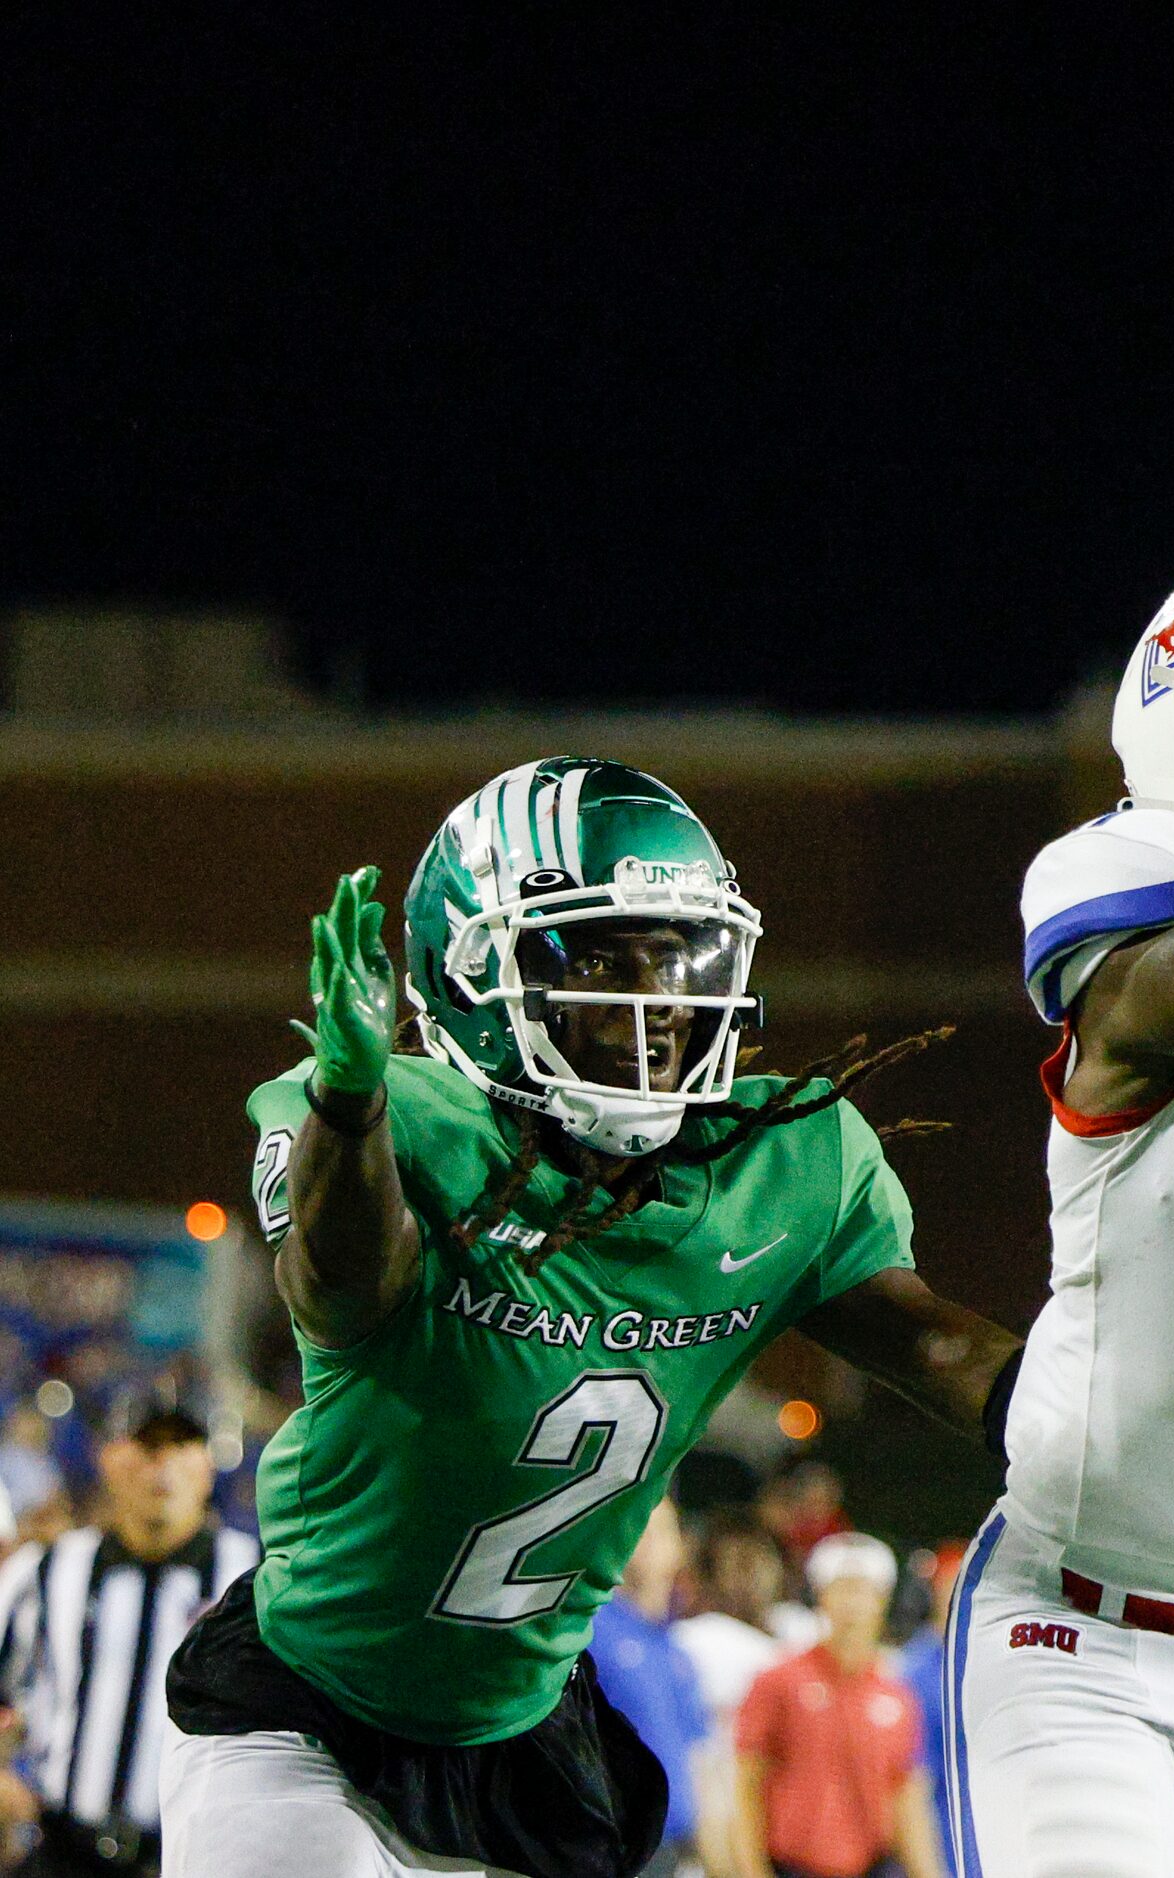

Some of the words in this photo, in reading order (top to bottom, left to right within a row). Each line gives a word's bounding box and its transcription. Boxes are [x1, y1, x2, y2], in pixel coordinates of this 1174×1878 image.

[256, 1127, 296, 1238] 2
[443, 1277, 595, 1349] MEAN
[602, 1305, 763, 1350] GREEN
[431, 1369, 669, 1628] 2
[1009, 1622, 1080, 1655] SMU
